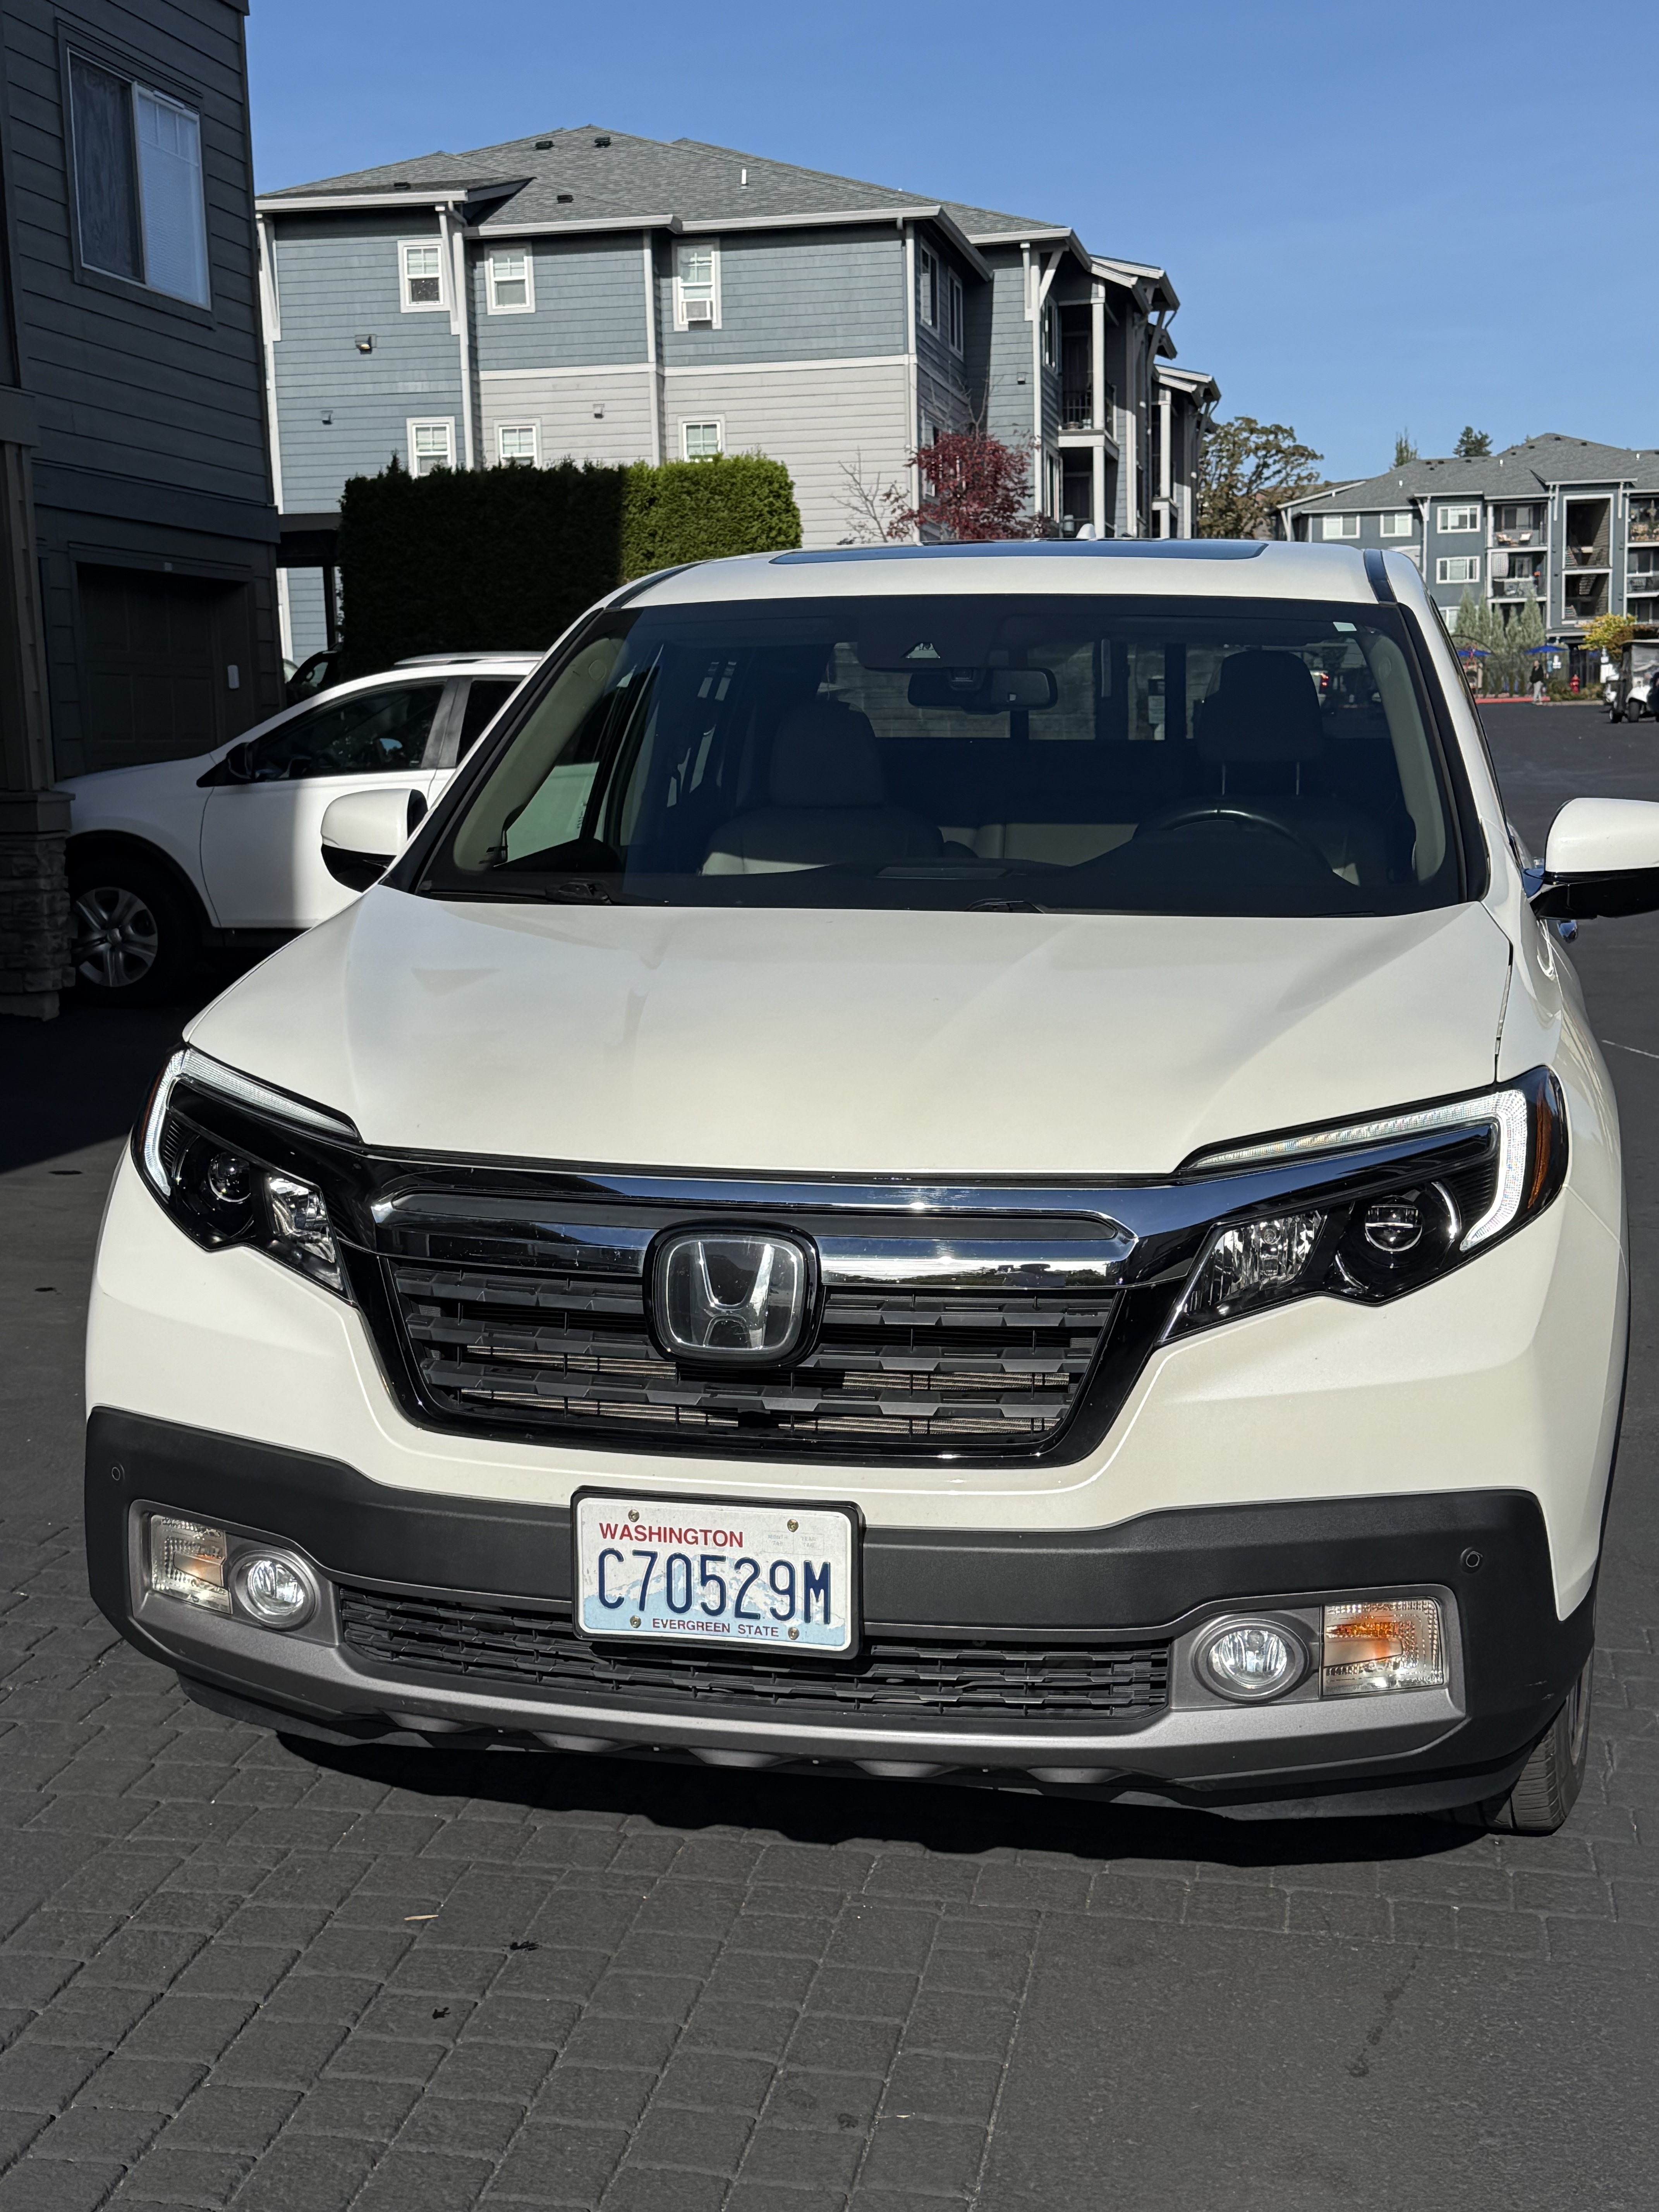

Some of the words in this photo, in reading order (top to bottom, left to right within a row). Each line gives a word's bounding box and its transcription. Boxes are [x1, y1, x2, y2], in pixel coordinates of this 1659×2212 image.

[599, 1523, 743, 1547] WASHINGTON
[598, 1547, 831, 1625] C70529M
[653, 1618, 730, 1633] EVERGREEN
[738, 1624, 779, 1637] STATE
